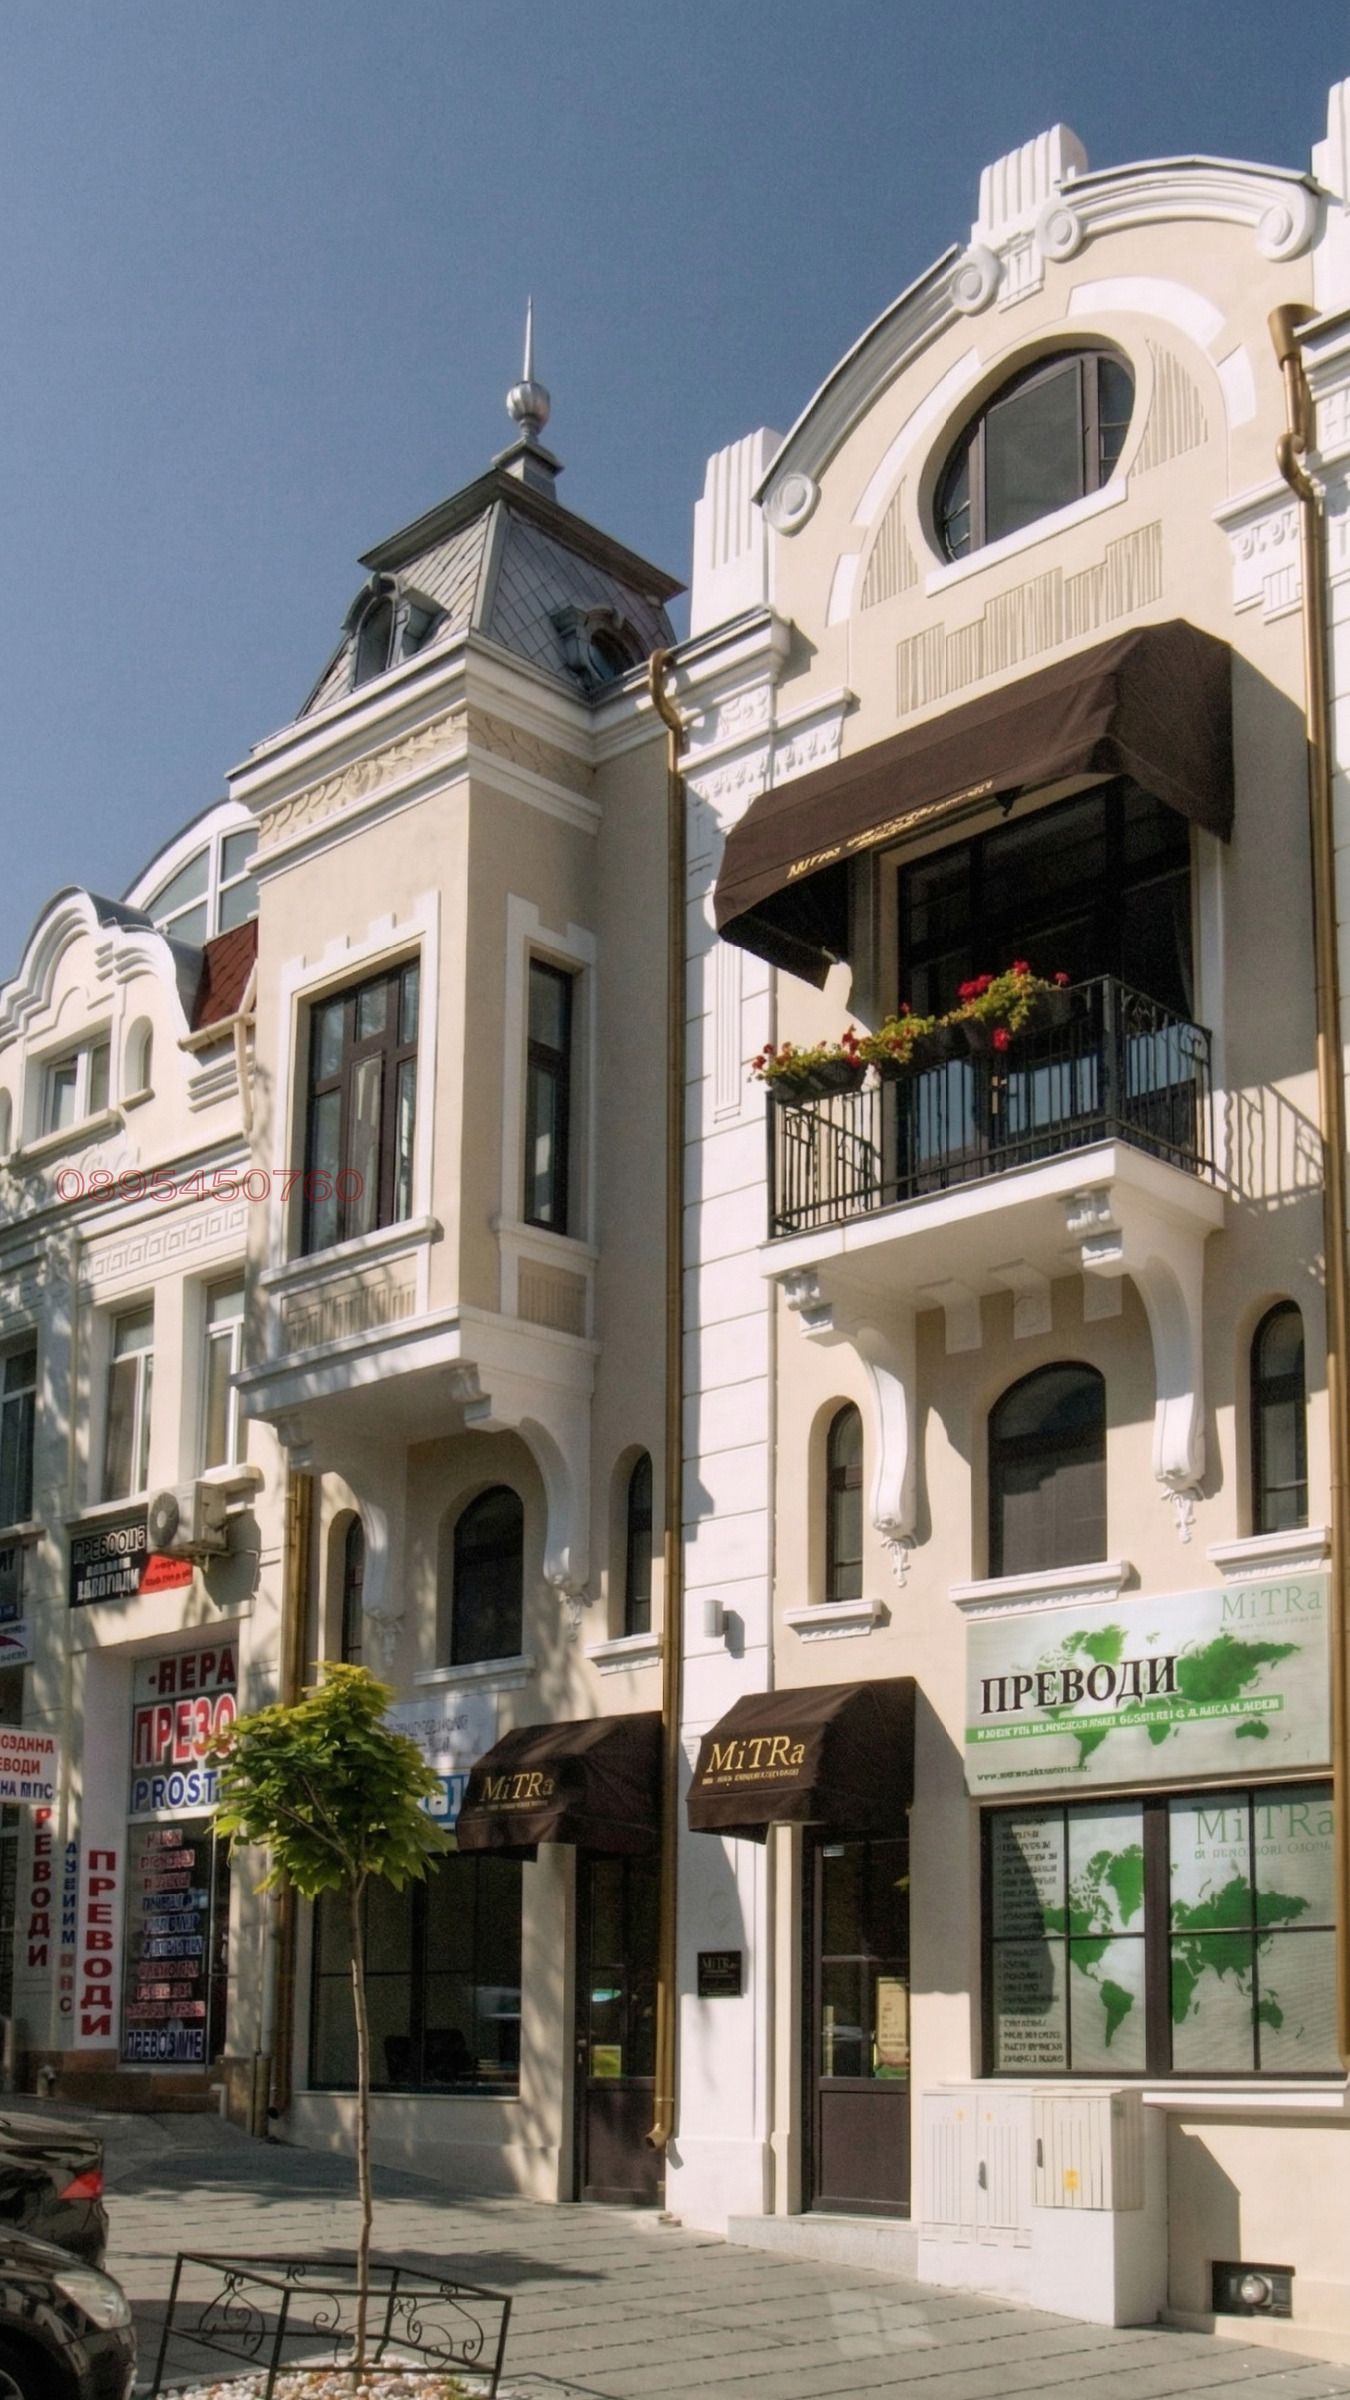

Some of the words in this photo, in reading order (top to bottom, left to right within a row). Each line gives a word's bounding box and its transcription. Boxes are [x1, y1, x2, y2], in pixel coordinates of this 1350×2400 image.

[1220, 1585, 1323, 1622] MiTRa
[979, 1655, 1179, 1716] ПРЕВОДИ
[706, 1735, 805, 1774] MiTRa
[135, 1770, 221, 1810] PROST
[478, 1771, 555, 1802] MiTRa
[1191, 1801, 1335, 1845] MiTRa
[80, 1850, 117, 2036] ПРЕВОДИ
